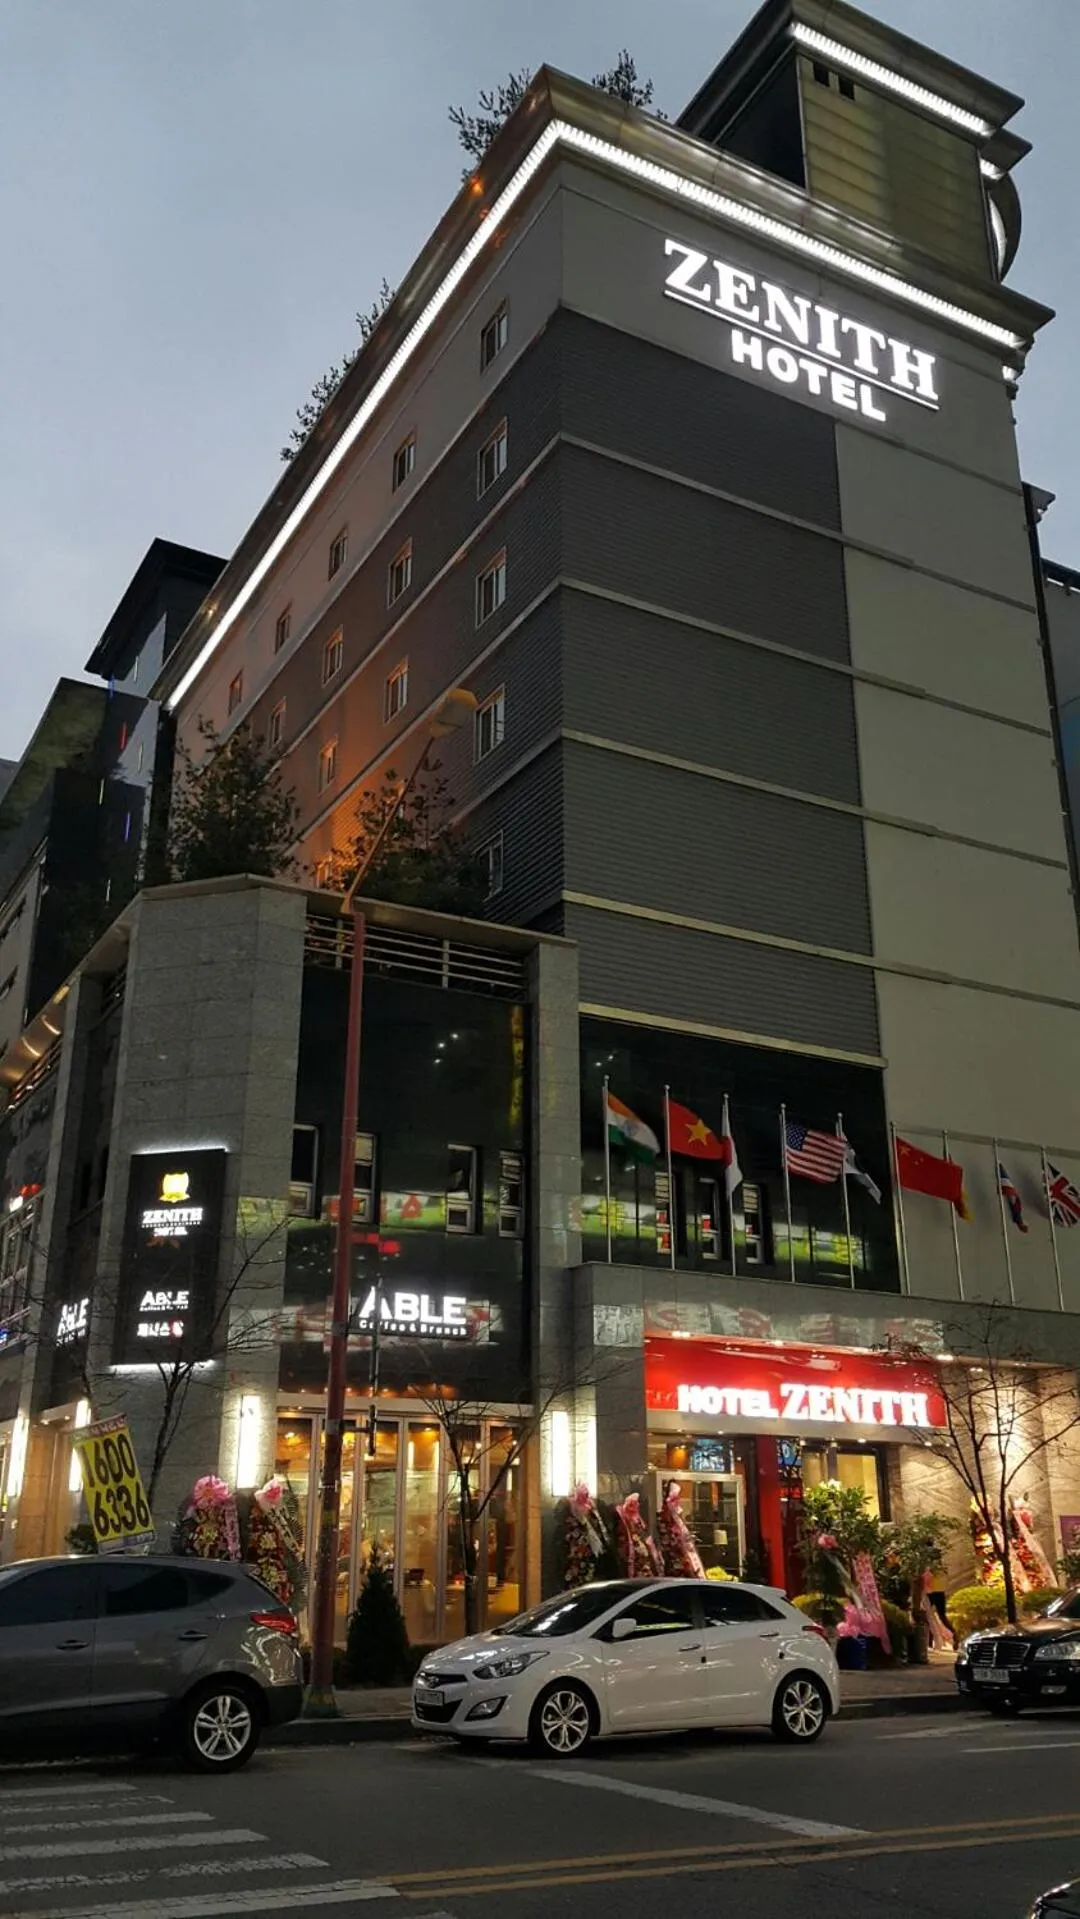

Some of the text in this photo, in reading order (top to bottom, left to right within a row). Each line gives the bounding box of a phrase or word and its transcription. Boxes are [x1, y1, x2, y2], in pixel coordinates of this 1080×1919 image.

[664, 238, 939, 400] ZENITH
[731, 329, 886, 422] HOTEL
[140, 1290, 190, 1306] ABLE
[359, 1286, 467, 1325] ABLE
[359, 1319, 406, 1332] Cofee
[420, 1323, 467, 1335] Brunch
[677, 1383, 931, 1427] HOTEL ZENITH
[81, 1433, 136, 1488] 1600
[93, 1481, 149, 1537] 6336
